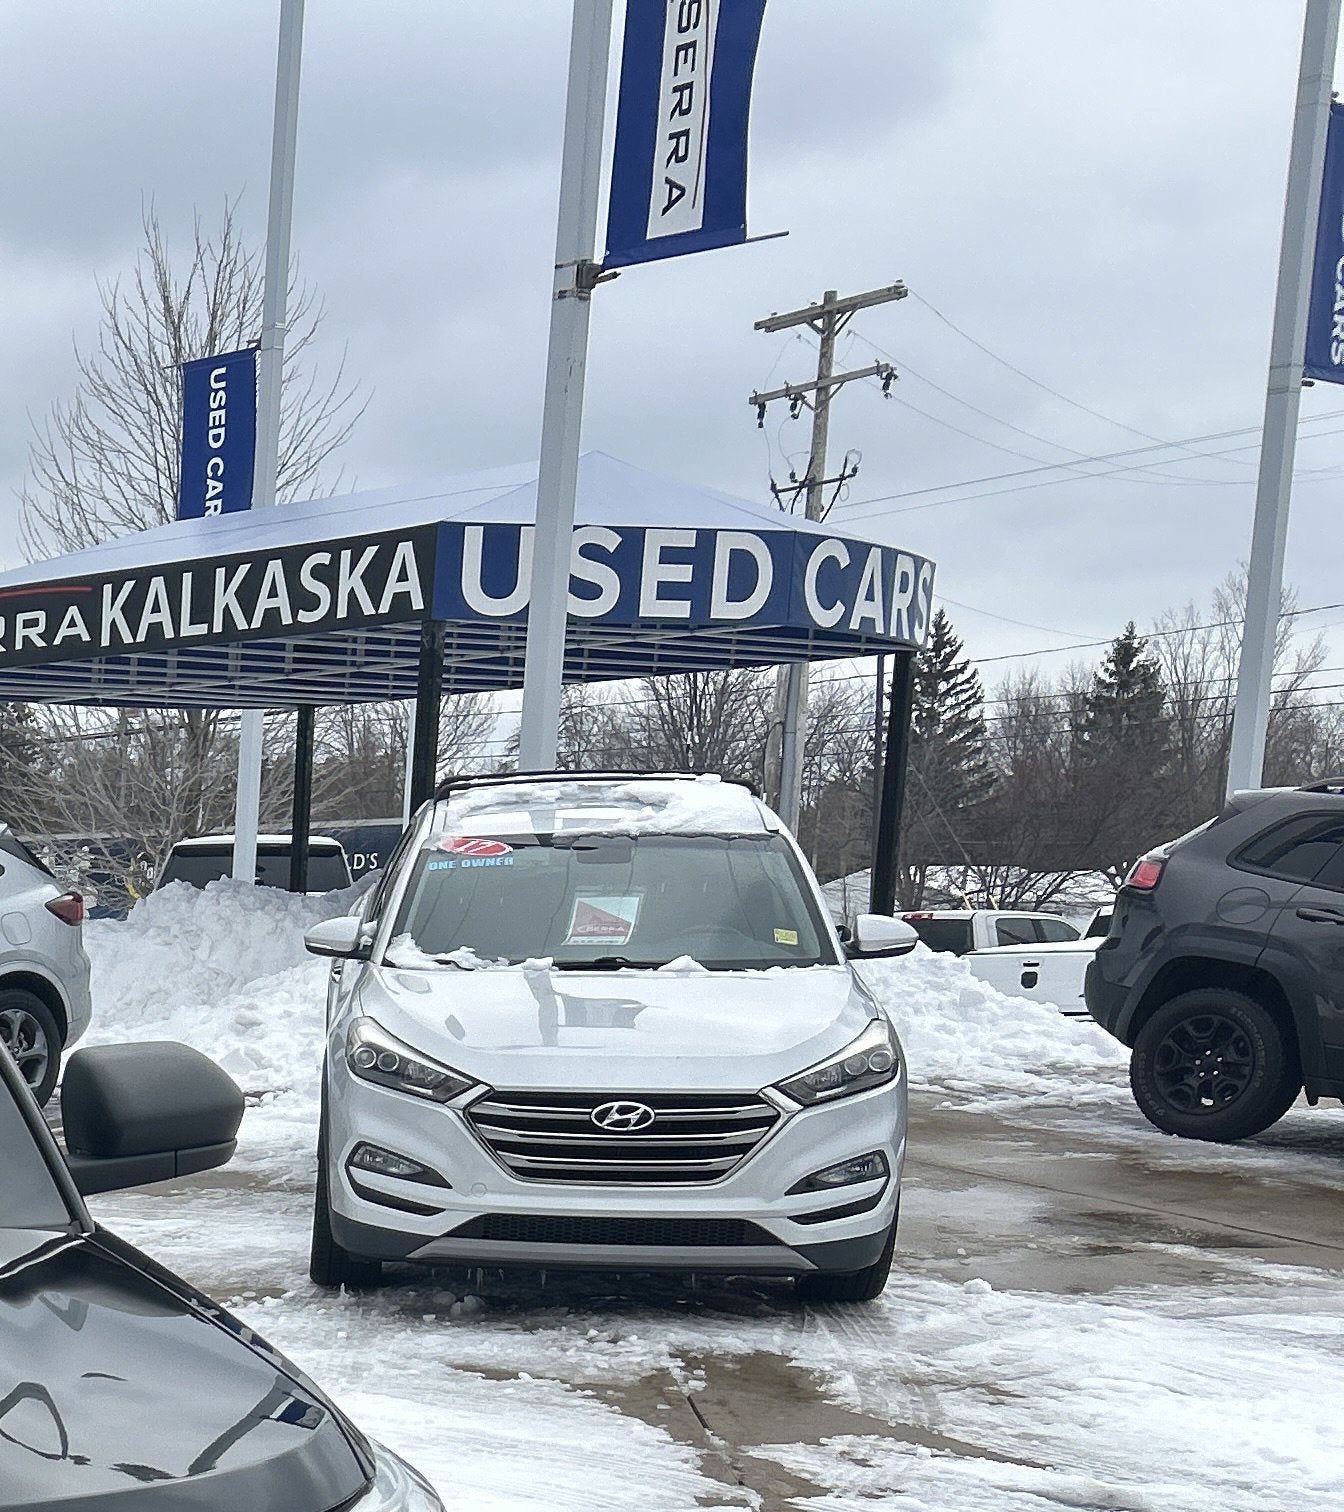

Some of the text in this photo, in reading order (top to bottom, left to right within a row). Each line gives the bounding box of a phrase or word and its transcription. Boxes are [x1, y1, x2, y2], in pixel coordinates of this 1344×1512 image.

[661, 0, 702, 217] SERRA
[204, 366, 227, 518] USED CAR
[99, 540, 425, 648] KALKASKA
[460, 525, 933, 647] USED CARS
[428, 856, 514, 871] ONE OWNER
[453, 839, 498, 853] 17
